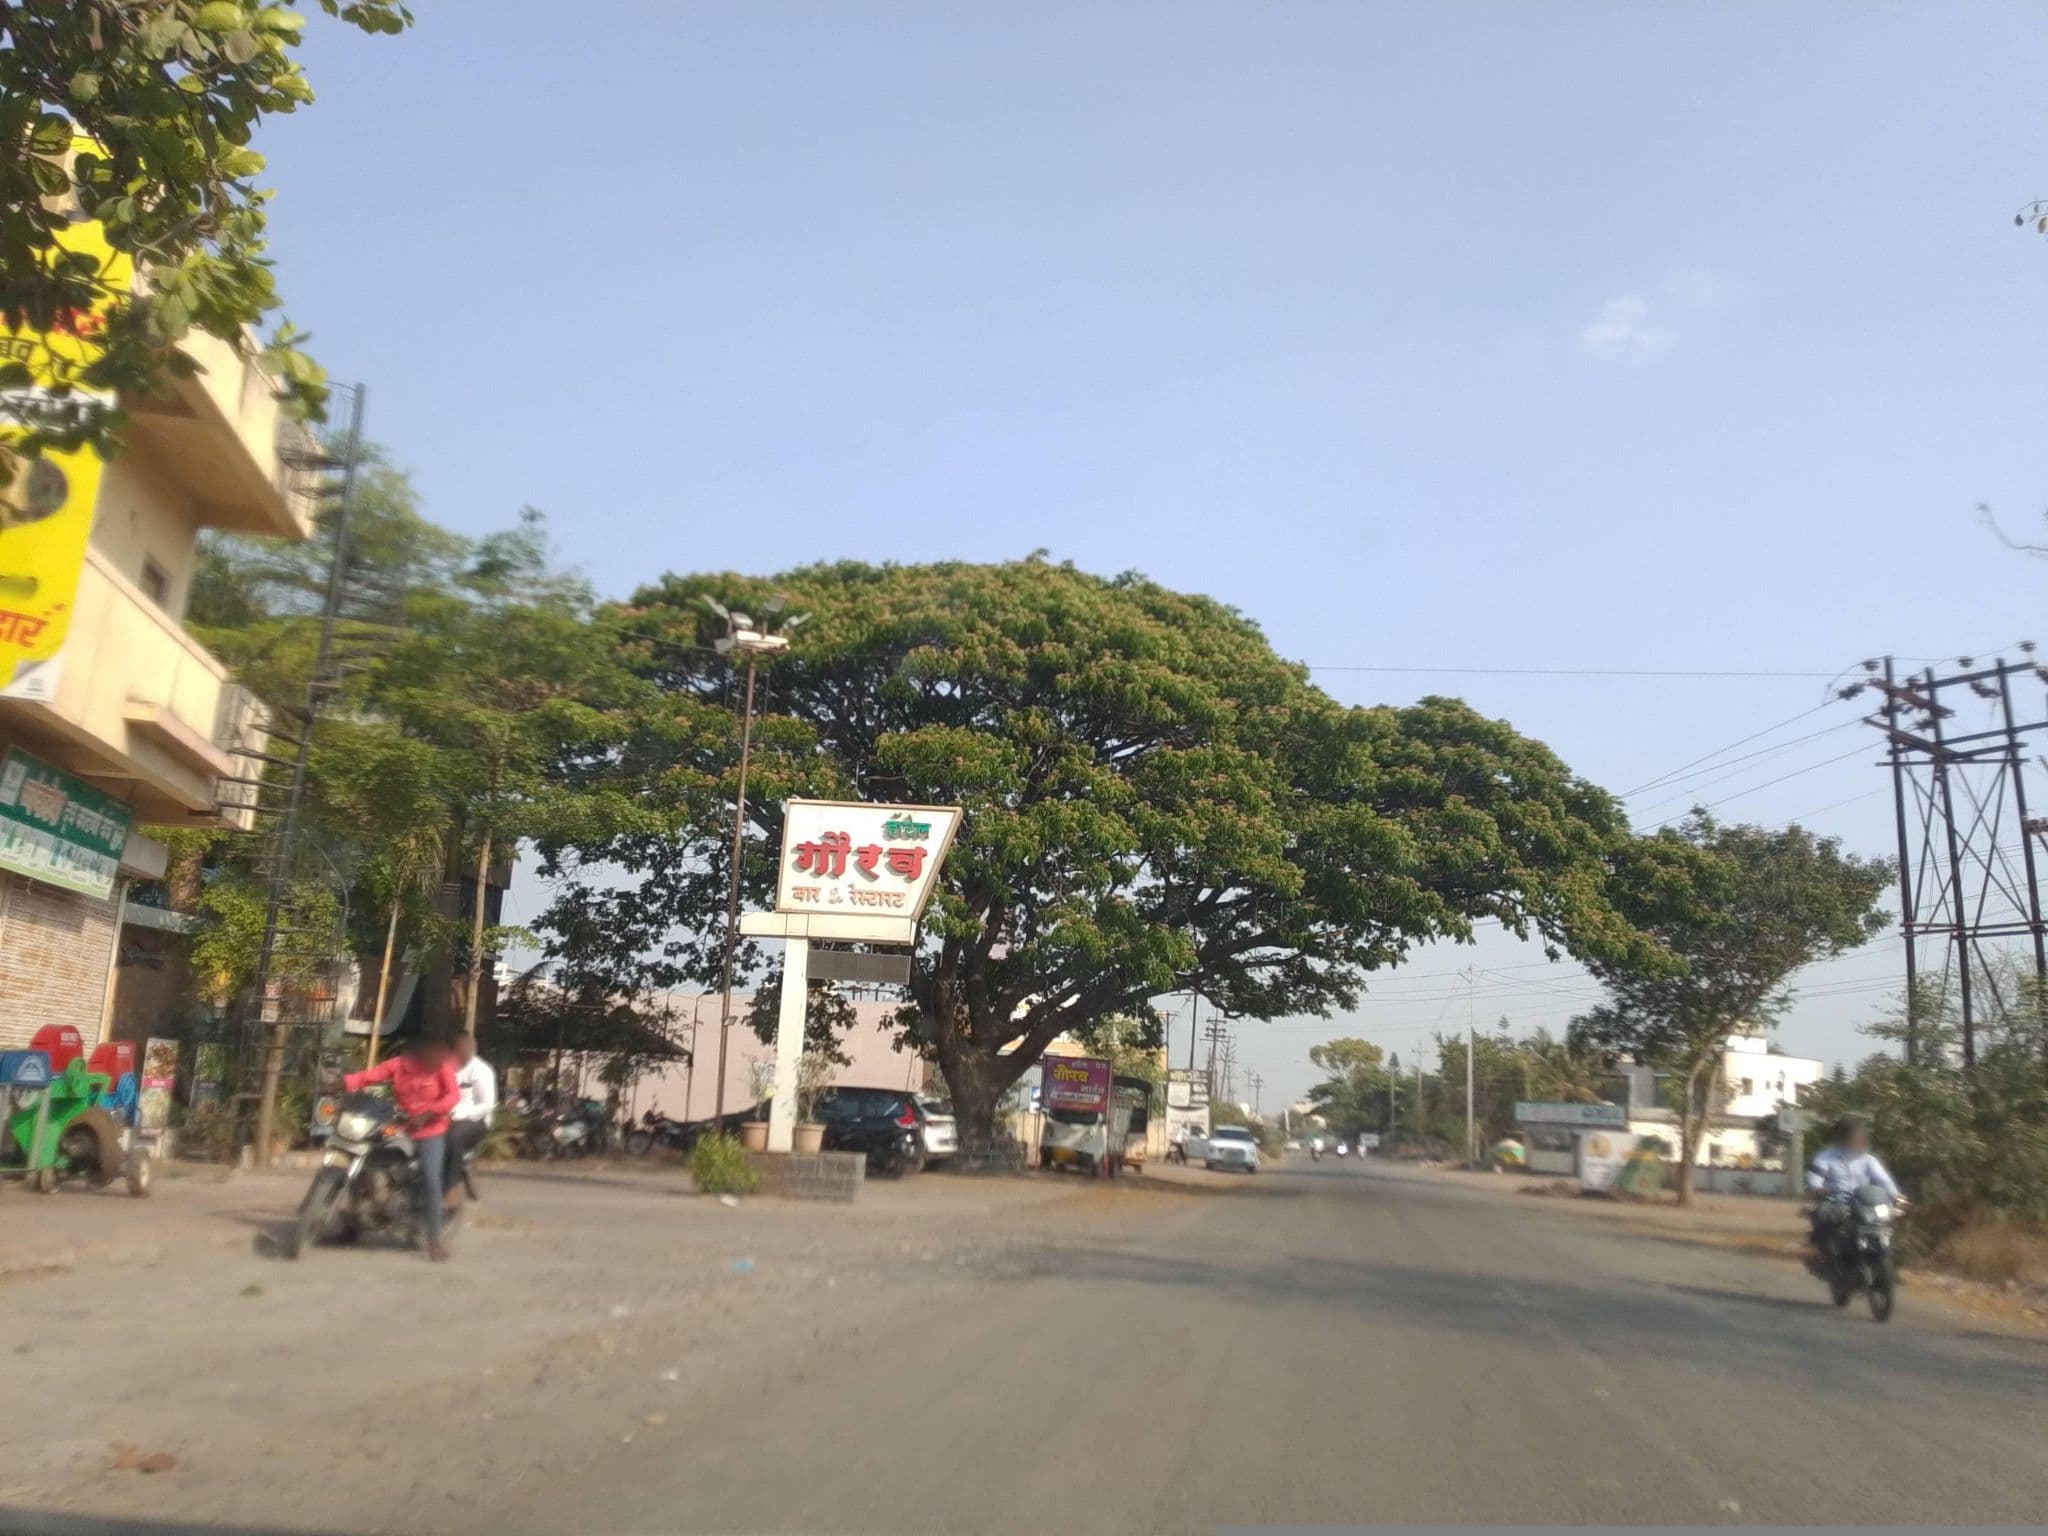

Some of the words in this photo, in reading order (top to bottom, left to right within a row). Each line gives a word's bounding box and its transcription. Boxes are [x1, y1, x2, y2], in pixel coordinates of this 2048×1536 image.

[795, 831, 928, 880] गौरव
[792, 886, 820, 904] बार
[1053, 1063, 1089, 1083] गौरव
